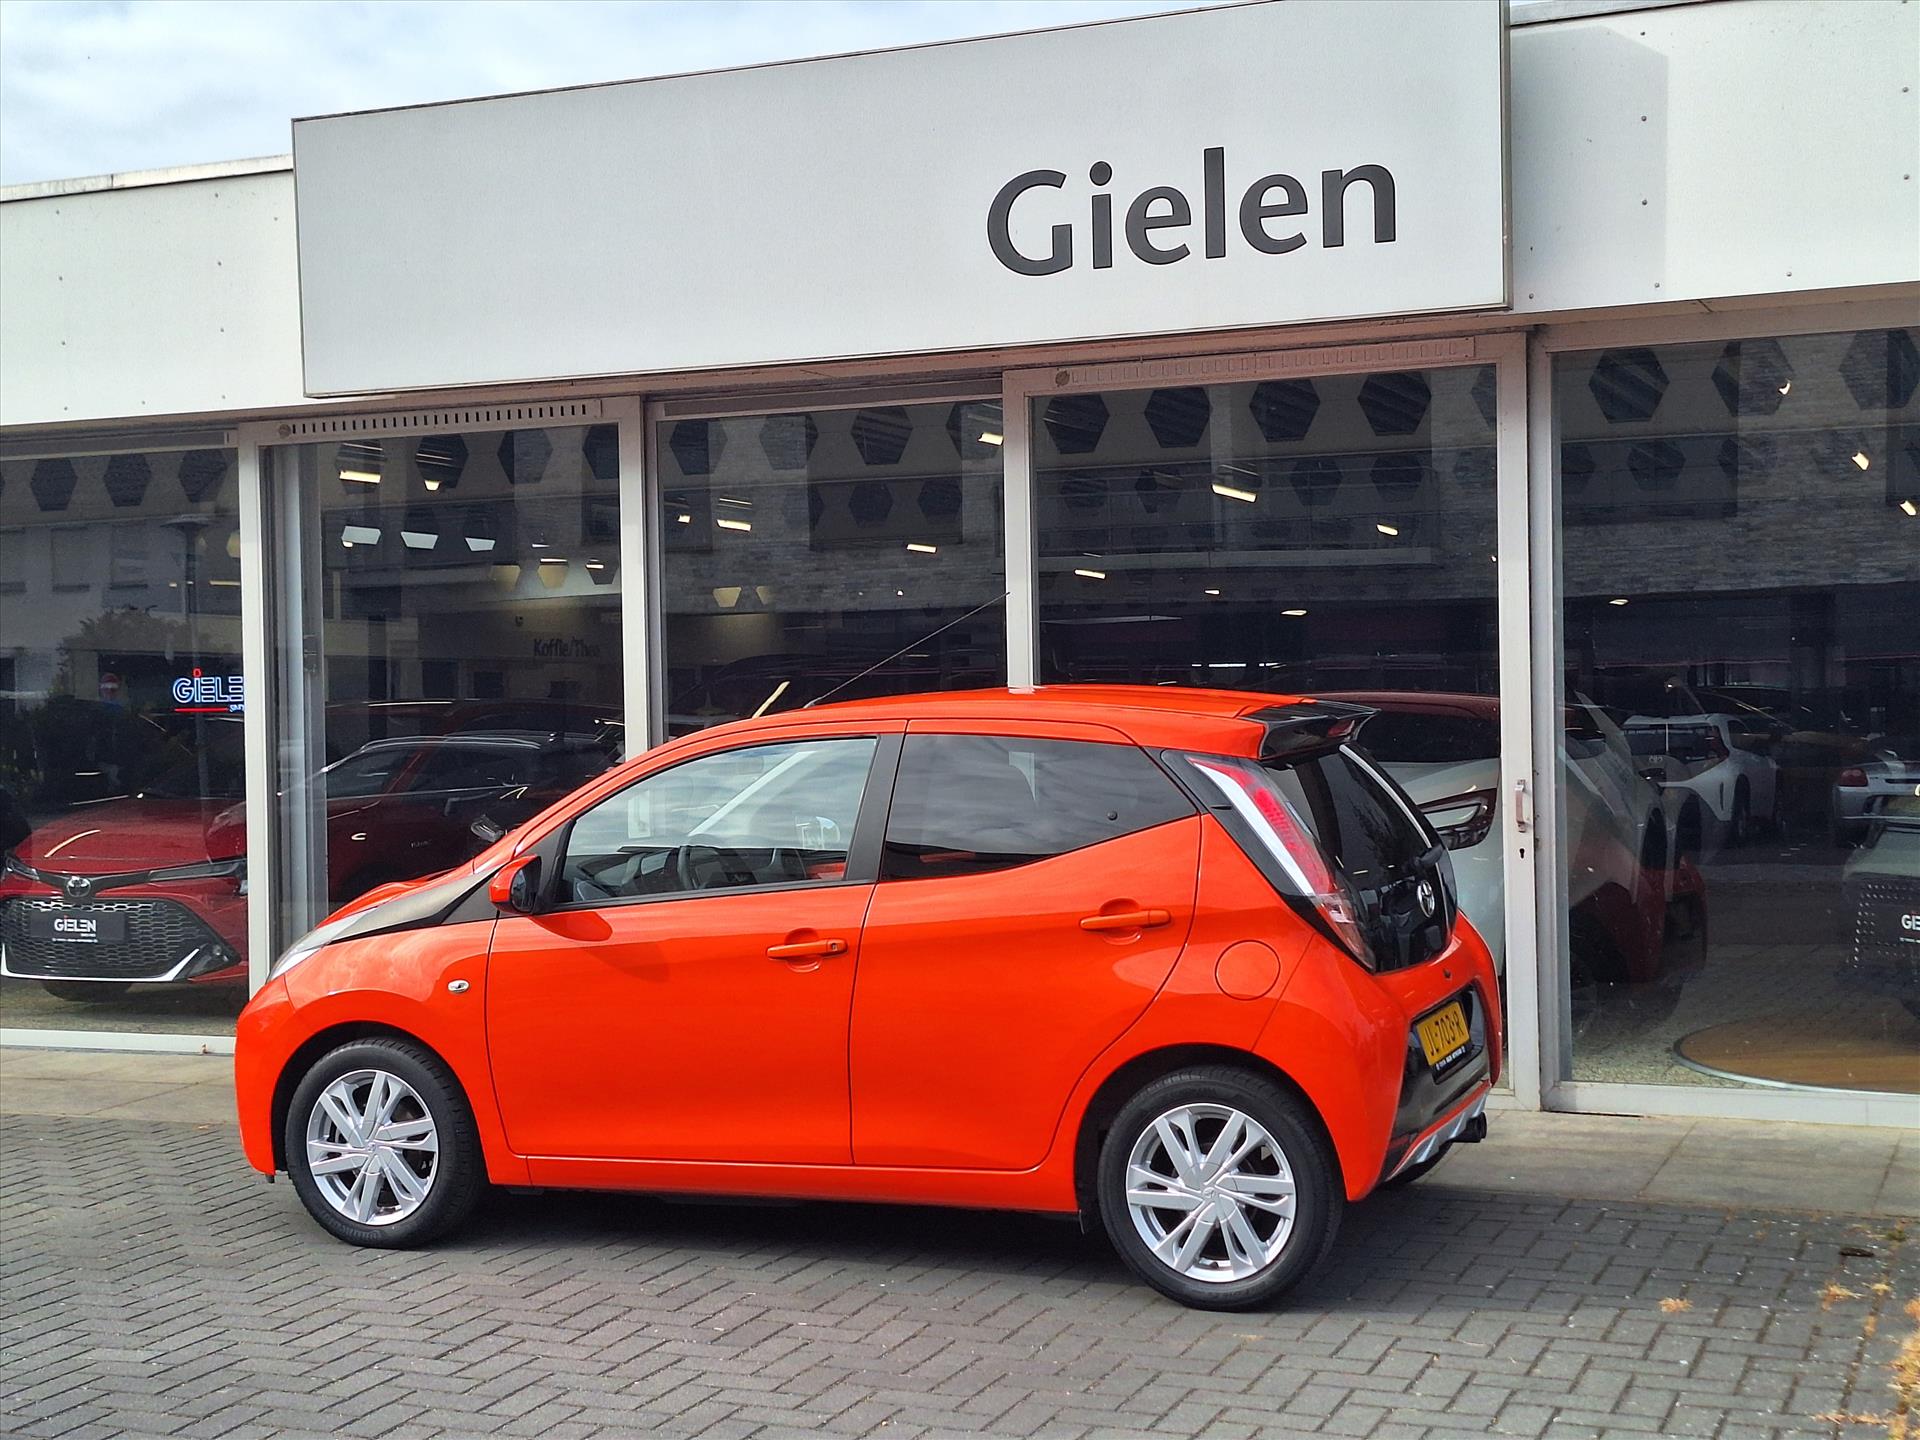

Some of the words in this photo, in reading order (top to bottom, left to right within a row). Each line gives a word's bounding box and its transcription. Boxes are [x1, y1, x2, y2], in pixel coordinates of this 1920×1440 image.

[987, 147, 1396, 276] Gielen
[172, 667, 243, 704] GIELE
[54, 914, 97, 932] GIELEN
[1425, 1011, 1464, 1057] JL-703-R
